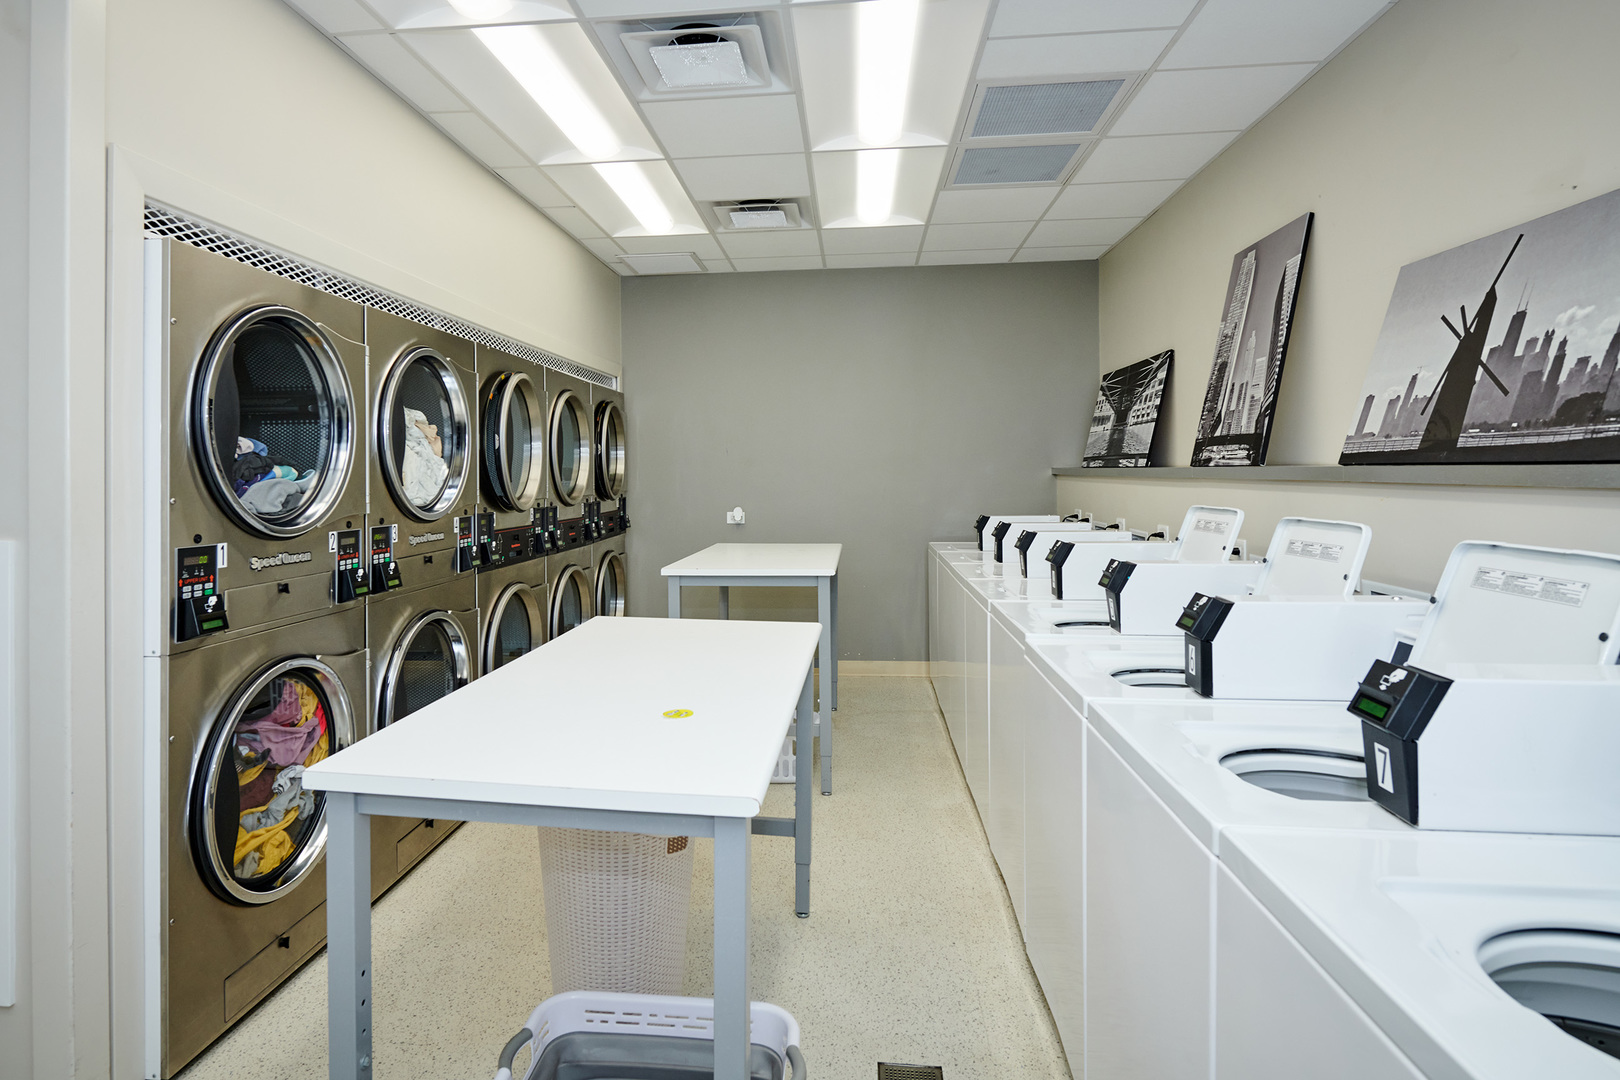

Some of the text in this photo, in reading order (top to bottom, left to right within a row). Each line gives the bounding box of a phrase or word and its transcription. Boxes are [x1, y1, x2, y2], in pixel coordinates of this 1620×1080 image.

[330, 533, 336, 550] 2
[392, 525, 397, 541] 3
[250, 551, 312, 571] Speed Queen
[1190, 647, 1194, 672] 6
[1378, 748, 1387, 784] 7
